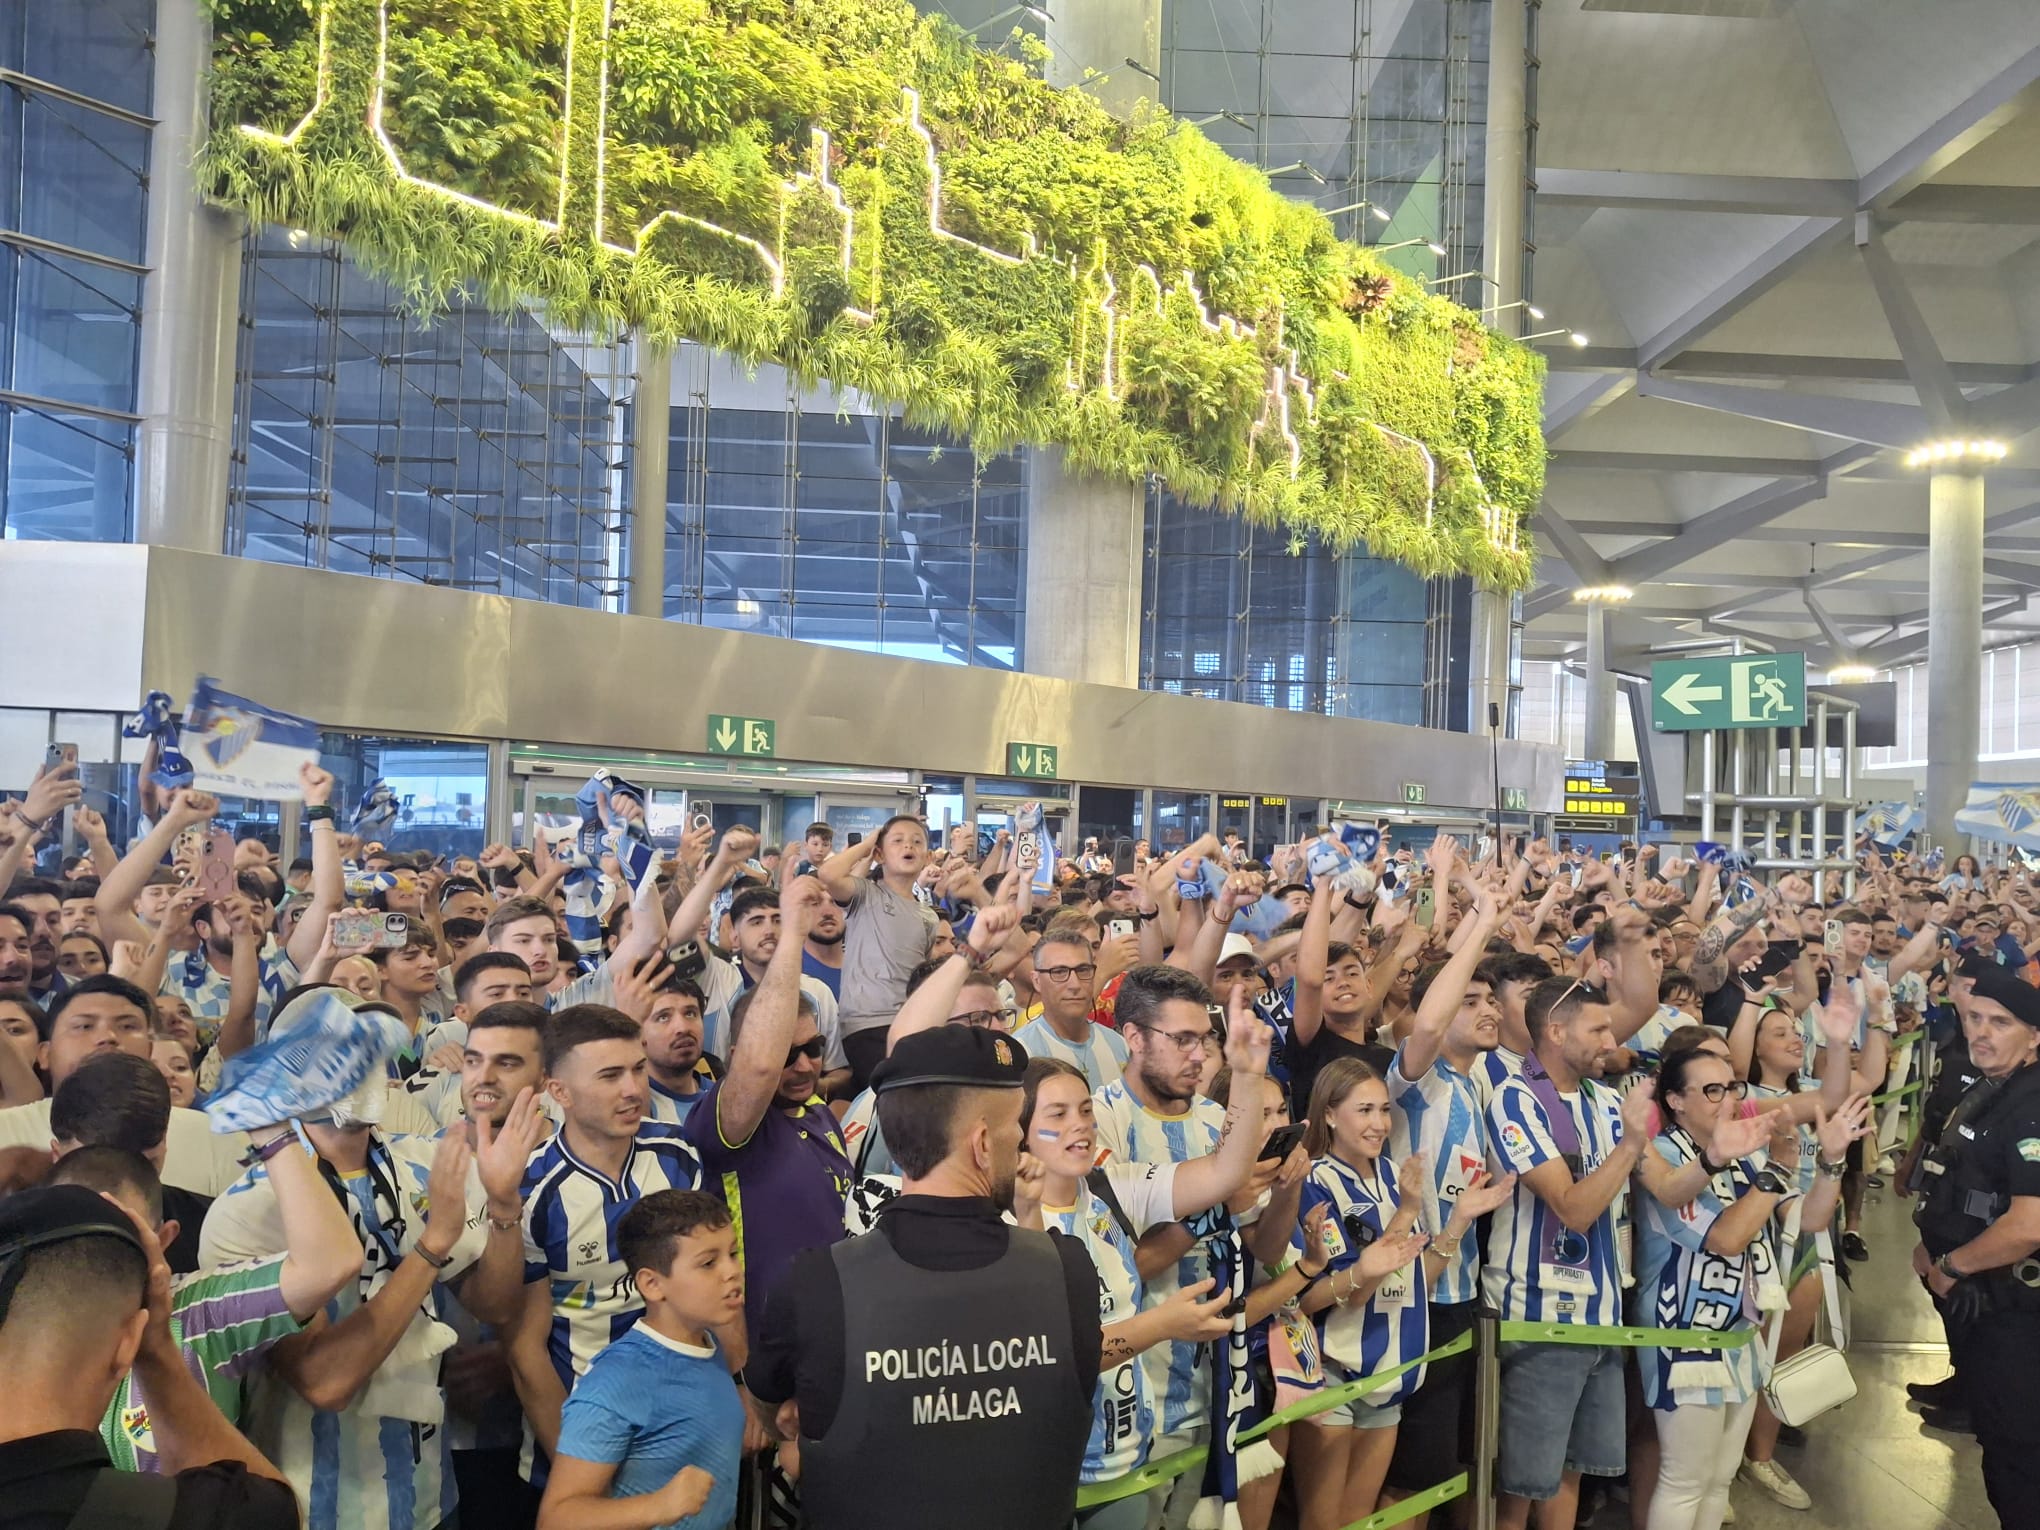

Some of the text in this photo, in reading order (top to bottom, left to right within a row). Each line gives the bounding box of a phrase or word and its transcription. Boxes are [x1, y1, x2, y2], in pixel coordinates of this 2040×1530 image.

[1510, 1144, 1531, 1157] LaLiga
[577, 1256, 602, 1266] hummel
[1329, 1245, 1341, 1256] LFP
[866, 1335, 1057, 1383] POLICÍA LOCAL
[913, 1386, 1022, 1425] MÁLAGA
[1115, 1364, 1137, 1439] Olin
